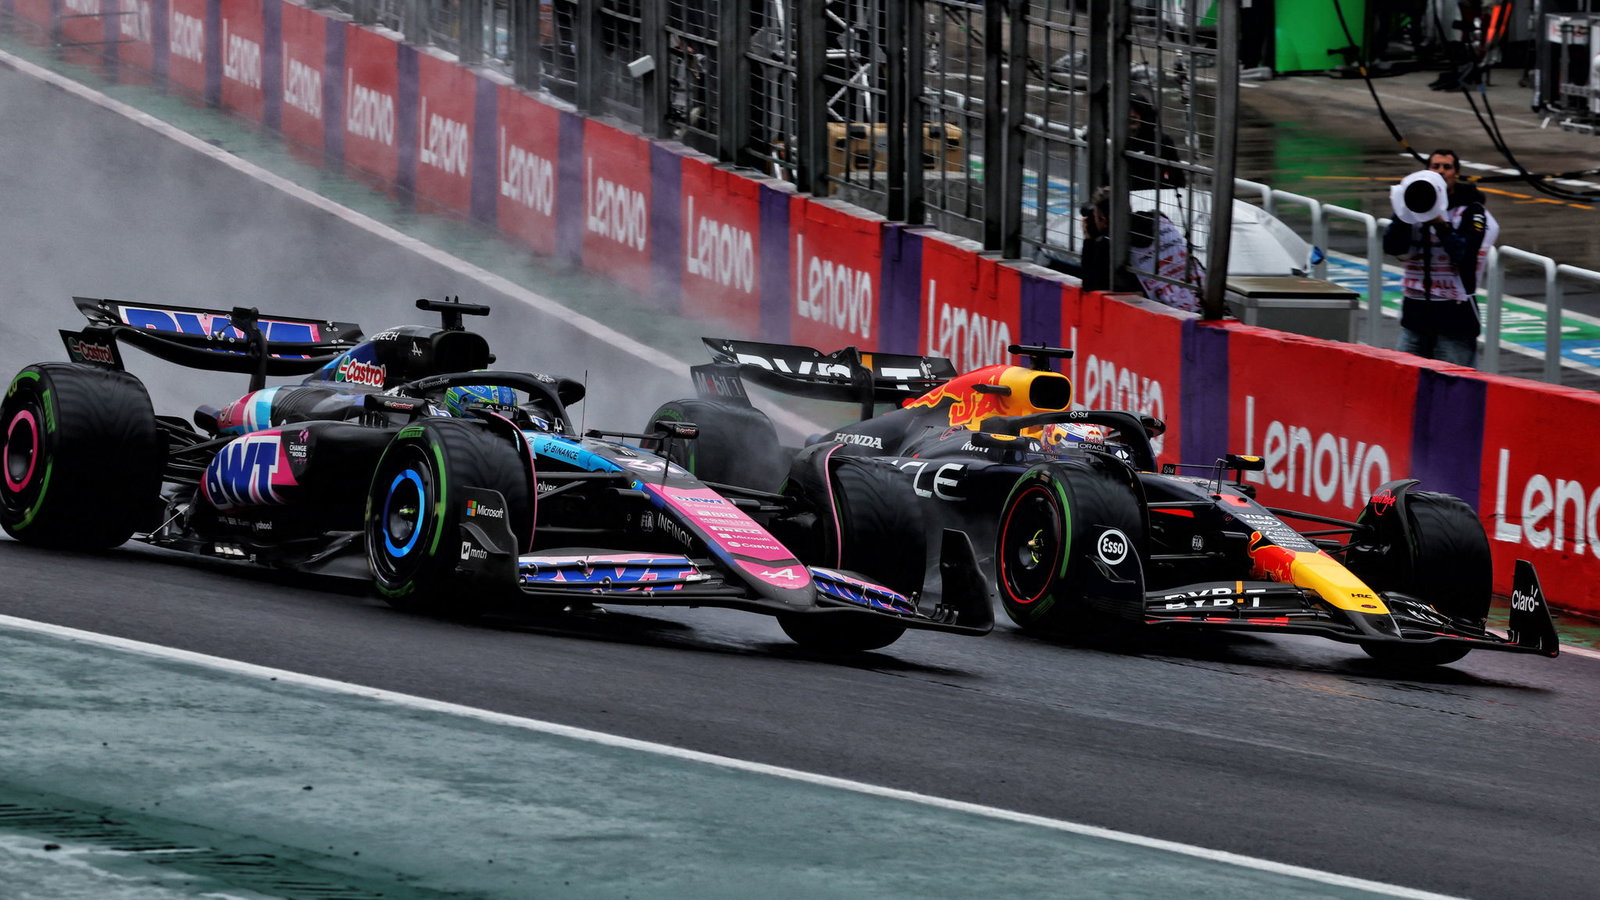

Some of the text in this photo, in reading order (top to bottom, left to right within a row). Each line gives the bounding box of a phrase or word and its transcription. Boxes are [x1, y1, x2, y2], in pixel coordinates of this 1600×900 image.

[222, 18, 261, 90] Lenovo
[283, 42, 322, 120] Lenovo
[347, 67, 394, 146] Lenovo
[420, 96, 468, 177] Lenovo
[500, 125, 553, 217] Lenovo
[587, 156, 646, 252] Lenovo
[687, 195, 753, 293] Lenovo
[797, 233, 872, 339] Lenovo
[79, 339, 115, 364] Castrol
[927, 279, 1011, 373] Lenovo
[346, 359, 386, 388] Castrol
[693, 371, 731, 397] Mobil
[551, 446, 579, 460] BINANCE
[833, 432, 884, 450] HONDA
[1245, 395, 1391, 510] Lenovo
[204, 437, 281, 507] BWT
[476, 504, 504, 519] Microsoft
[657, 512, 694, 550] INFINOX
[470, 548, 488, 559] mntn
[741, 541, 781, 551] Castrol
[1102, 537, 1124, 555] Esso
[1511, 589, 1536, 612] Claro
